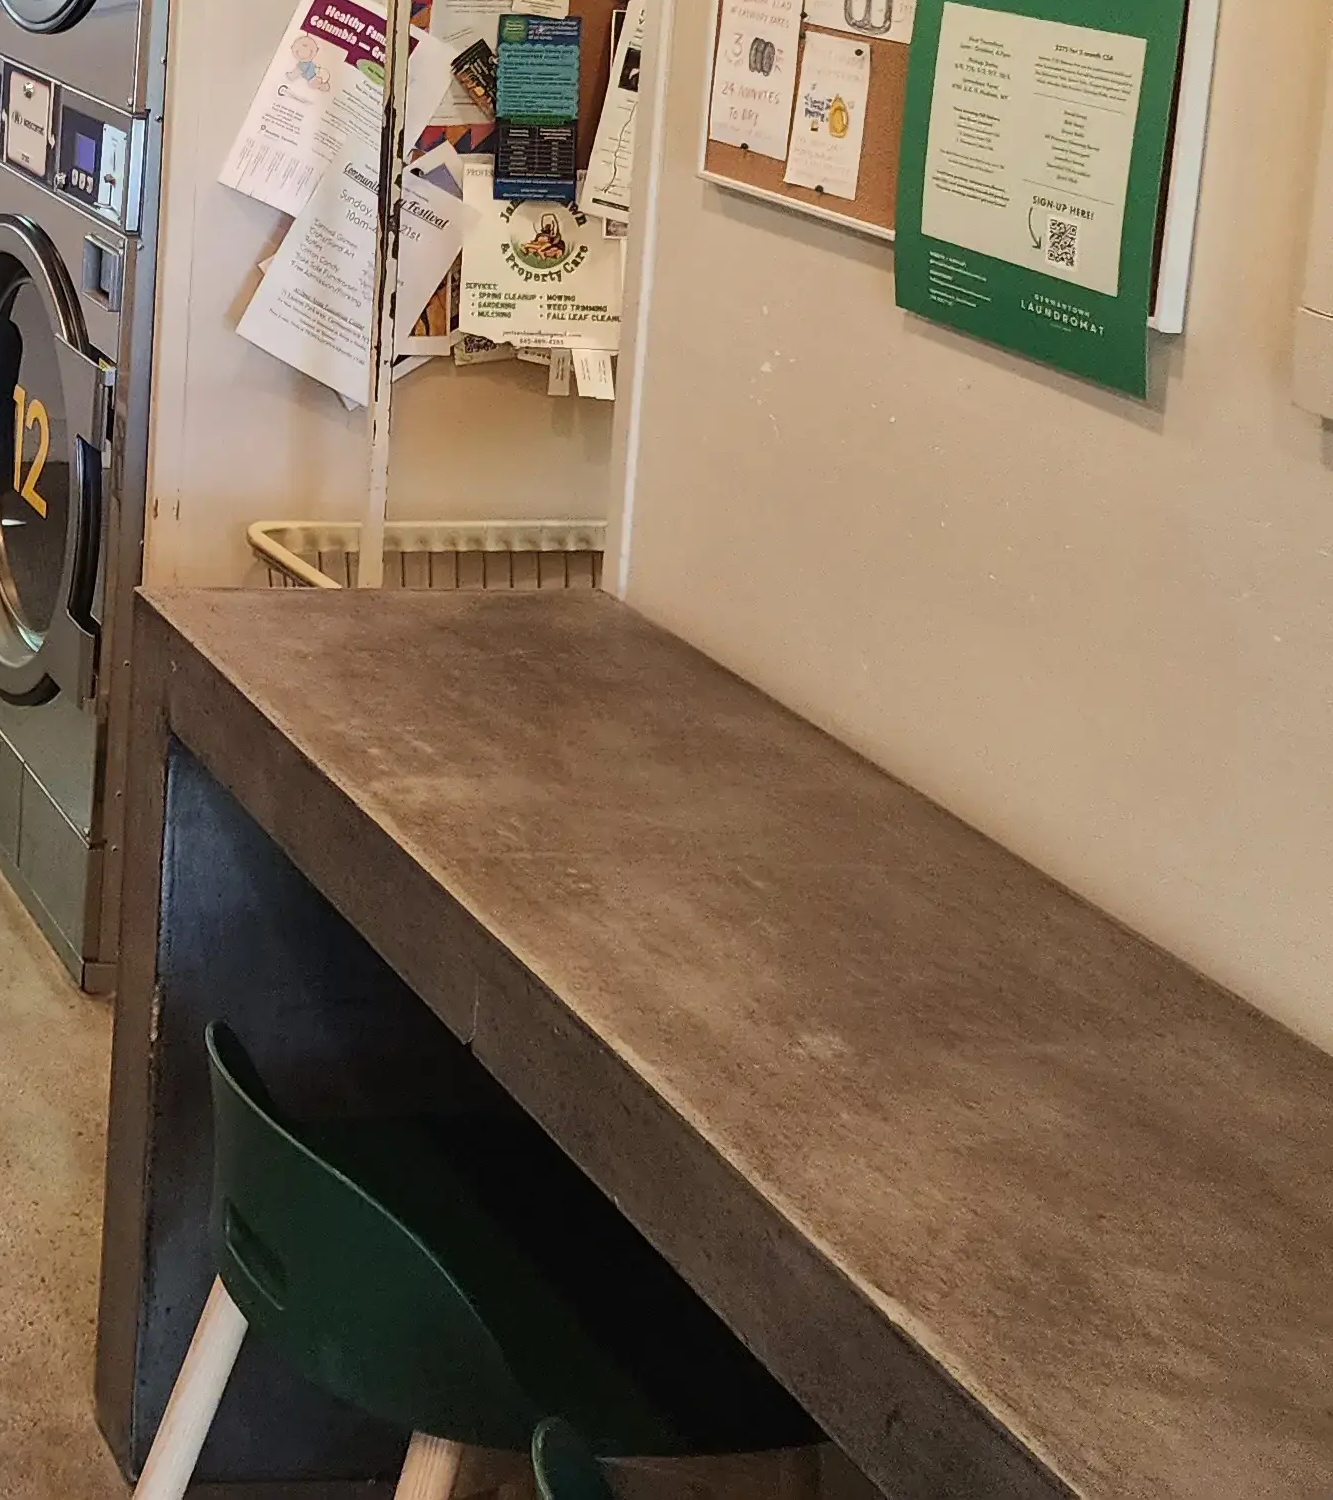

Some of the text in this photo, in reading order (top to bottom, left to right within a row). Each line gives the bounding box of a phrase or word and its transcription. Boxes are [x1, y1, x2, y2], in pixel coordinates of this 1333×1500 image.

[310, 15, 358, 45] Columbia
[325, 5, 365, 32] Healthy
[340, 189, 373, 218] Sunday,
[407, 198, 450, 230] Festival
[1033, 196, 1095, 221] SIGN-UP HERE!
[505, 254, 563, 283] Property
[562, 244, 589, 274] Care
[503, 293, 537, 301] CLEANUP
[570, 304, 608, 312] TRIMMING
[1033, 293, 1091, 318] GERMANTOWN
[546, 312, 589, 321] FALL LEAF
[1021, 299, 1105, 336] LAUNDROMAT
[13, 384, 50, 520] 12
